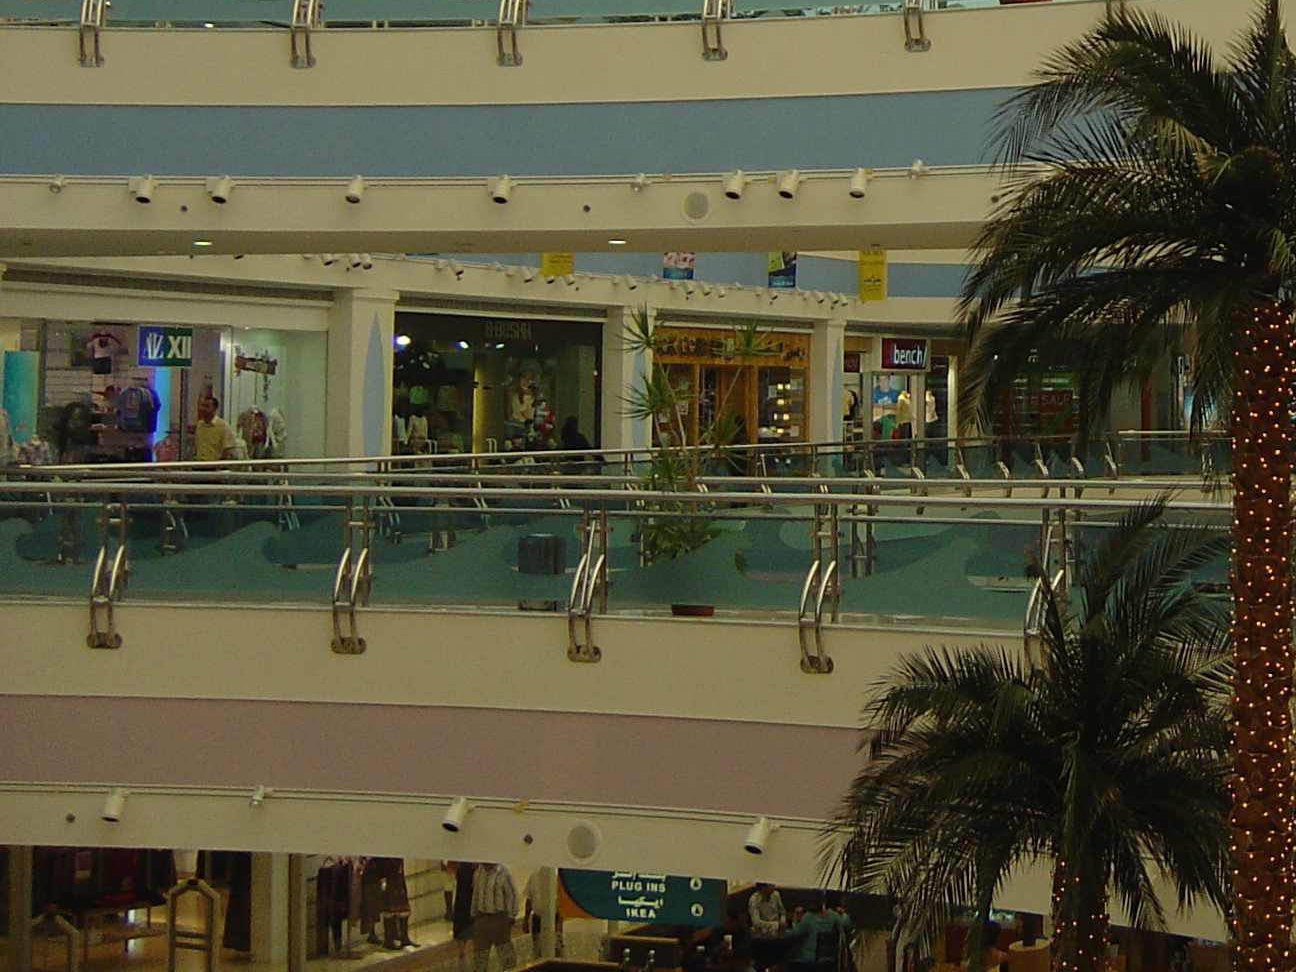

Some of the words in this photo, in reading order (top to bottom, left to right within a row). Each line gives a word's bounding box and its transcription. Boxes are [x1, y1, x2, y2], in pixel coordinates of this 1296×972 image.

[1041, 392, 1070, 406] SALE
[611, 880, 643, 891] PLUG
[646, 882, 667, 893] INS
[626, 907, 657, 918] IKEA
